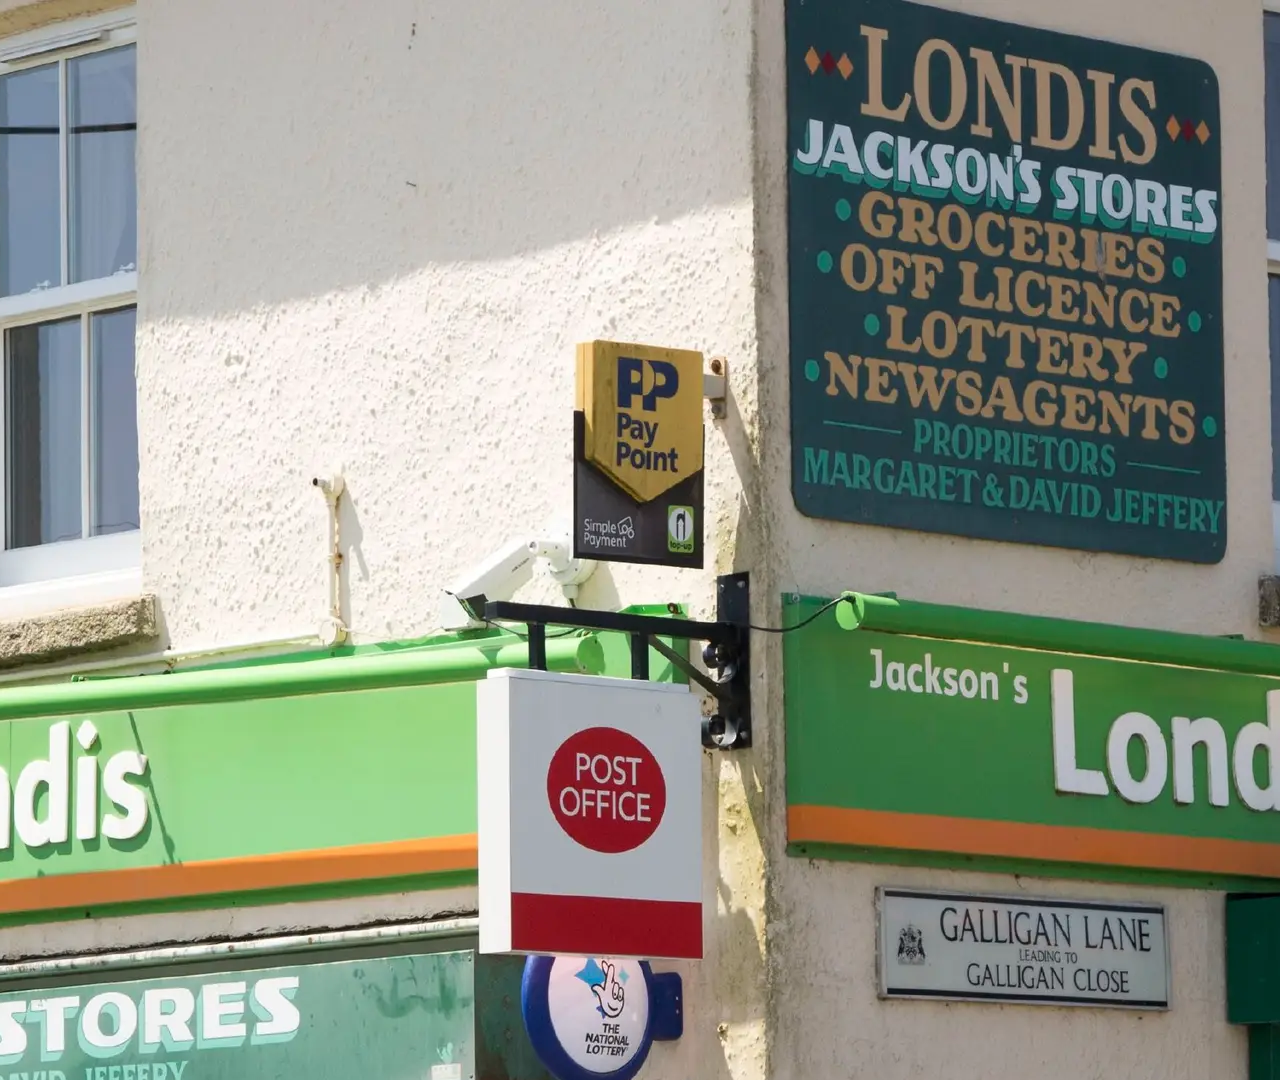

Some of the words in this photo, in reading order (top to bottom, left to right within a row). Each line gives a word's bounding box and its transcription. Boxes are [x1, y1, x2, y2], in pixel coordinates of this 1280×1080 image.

[859, 24, 1158, 166] LONDIS
[793, 119, 1042, 213] JACKSON'S
[1051, 165, 1218, 243] STORES
[858, 190, 1165, 284] GROCERIES
[840, 243, 944, 299] OFF
[958, 262, 1181, 339] LICENCE
[885, 305, 1148, 385] LOTTERY
[824, 351, 1196, 445] NEWSAGENTS
[617, 412, 659, 448] Pay
[913, 418, 1117, 478] PROPRIETORS
[616, 442, 678, 472] Point
[803, 447, 981, 503] MARGARET
[982, 472, 1005, 508] &
[1009, 476, 1101, 519] DAVID
[1106, 488, 1225, 535] JEFFERY
[584, 518, 616, 535] Simple
[584, 532, 626, 548] Payment
[670, 541, 692, 551] top-up
[869, 648, 1028, 704] Jackson's
[576, 752, 642, 787] POST
[559, 785, 652, 823] OFFICE
[940, 907, 1071, 948] GALLIGAN
[1083, 915, 1152, 953] LANE
[1019, 949, 1061, 964] LEADING
[1064, 951, 1078, 964] TO
[966, 963, 1065, 990] GALLIGAN
[1073, 968, 1130, 994] CLOSE
[585, 1033, 629, 1046] NATIONAL
[602, 1023, 620, 1034] THE
[586, 1044, 626, 1056] LOTTERY
